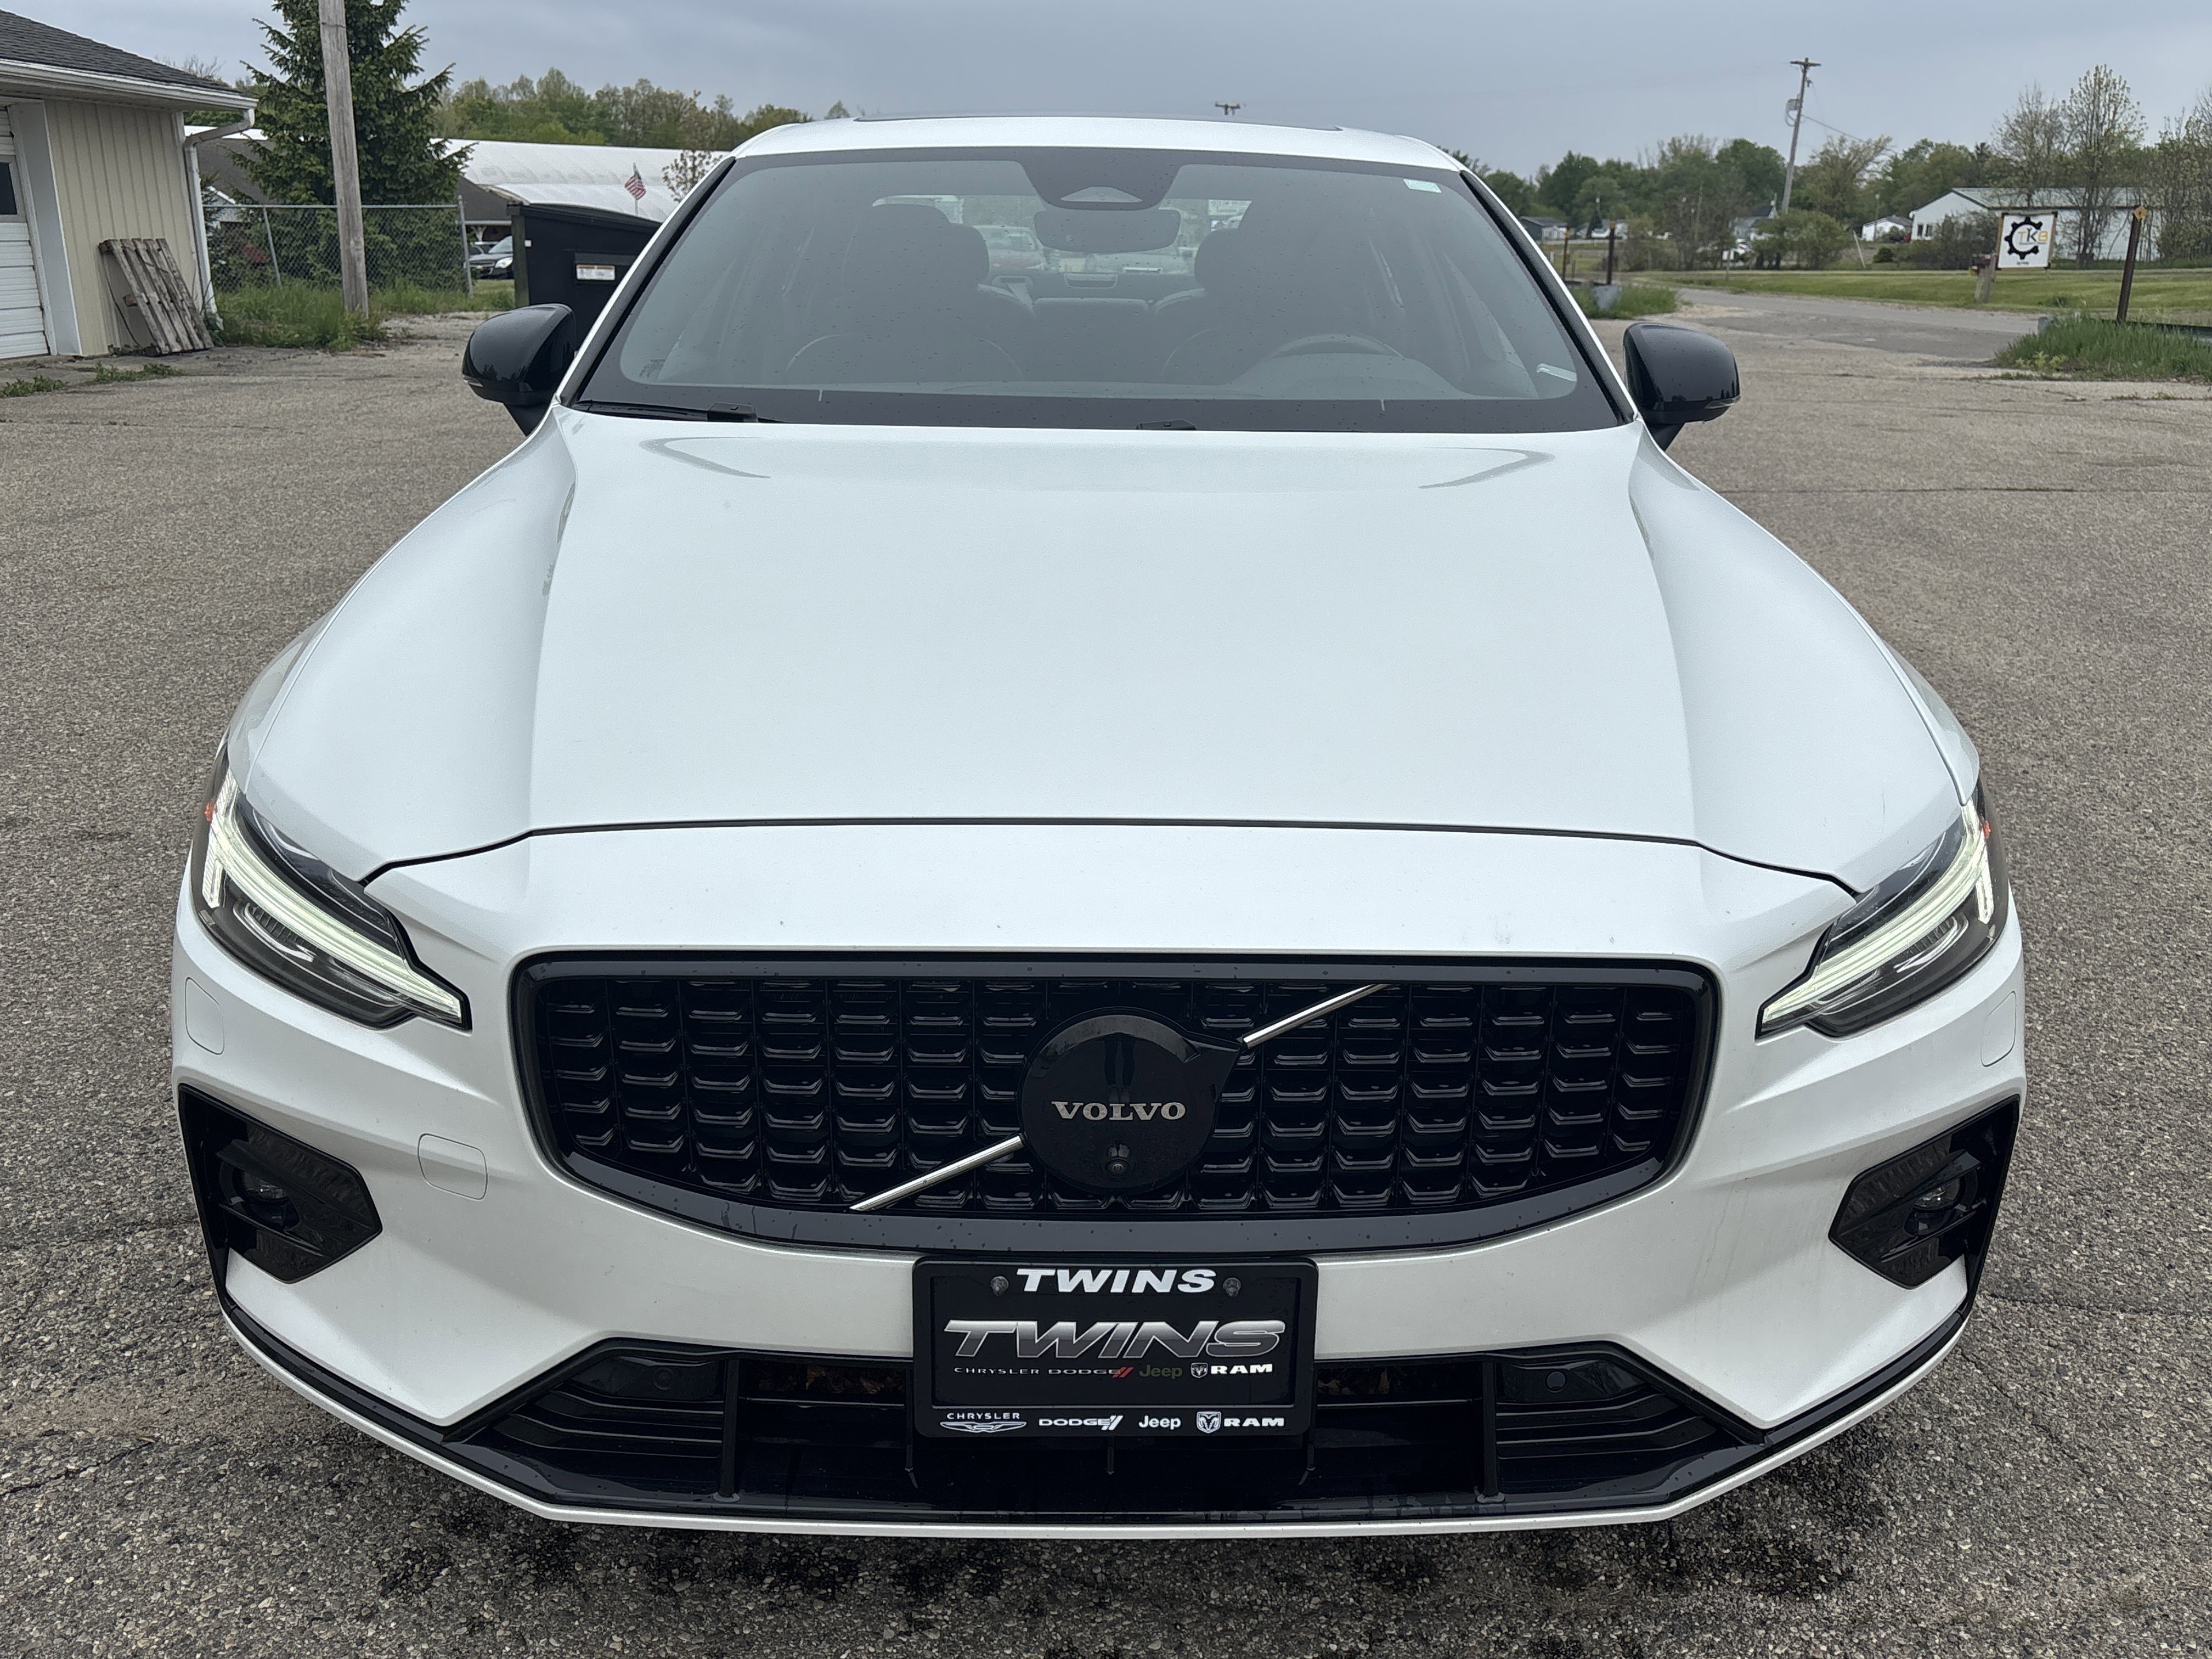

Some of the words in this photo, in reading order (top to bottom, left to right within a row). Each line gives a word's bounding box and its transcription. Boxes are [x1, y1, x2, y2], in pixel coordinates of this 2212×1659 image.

[2017, 228, 2048, 242] TKB
[1051, 1101, 1186, 1120] VOLVO
[1016, 1268, 1217, 1294] TWINS
[944, 1319, 1286, 1359] TWINS
[1139, 1364, 1183, 1379] Jeep
[1210, 1363, 1273, 1374] RAM
[946, 1412, 1020, 1420] CHRYSLER
[1039, 1418, 1111, 1426] DODGE
[1138, 1415, 1181, 1430] Jeep
[1223, 1418, 1285, 1427] RAM
